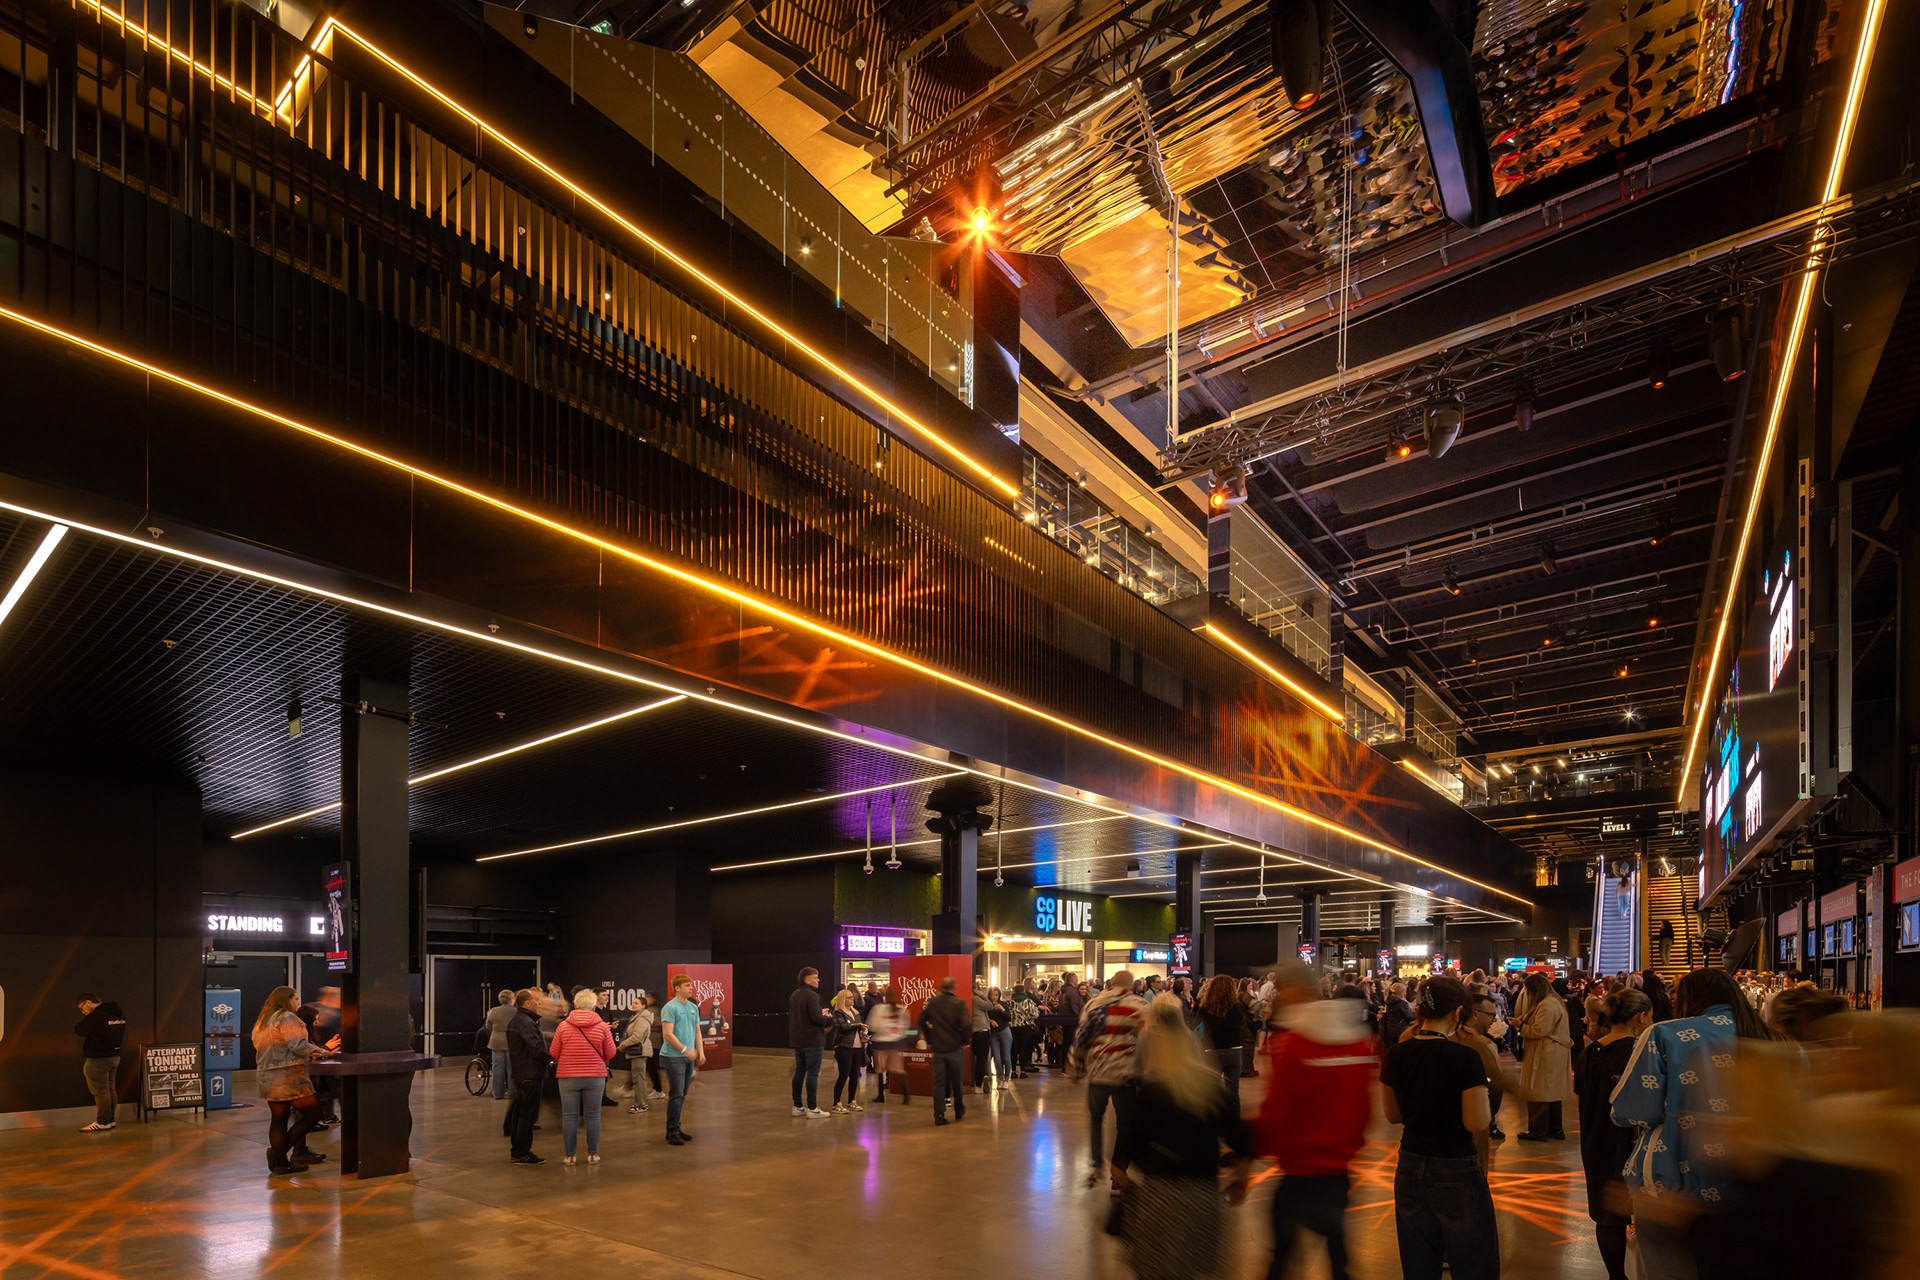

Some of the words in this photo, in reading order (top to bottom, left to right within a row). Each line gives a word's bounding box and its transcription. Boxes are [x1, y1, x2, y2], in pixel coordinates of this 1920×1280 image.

[1602, 823, 1625, 832] LEVEL
[1901, 871, 1912, 889] THE
[1057, 899, 1092, 932] LIVE
[208, 915, 283, 932] STANDING
[849, 939, 875, 948] SOUND
[879, 940, 903, 949] BITES
[605, 988, 646, 1011] LOO
[210, 1010, 234, 1023] LIVE
[147, 1047, 196, 1057] AFTERPARTY
[147, 1054, 196, 1067] TONIGHT
